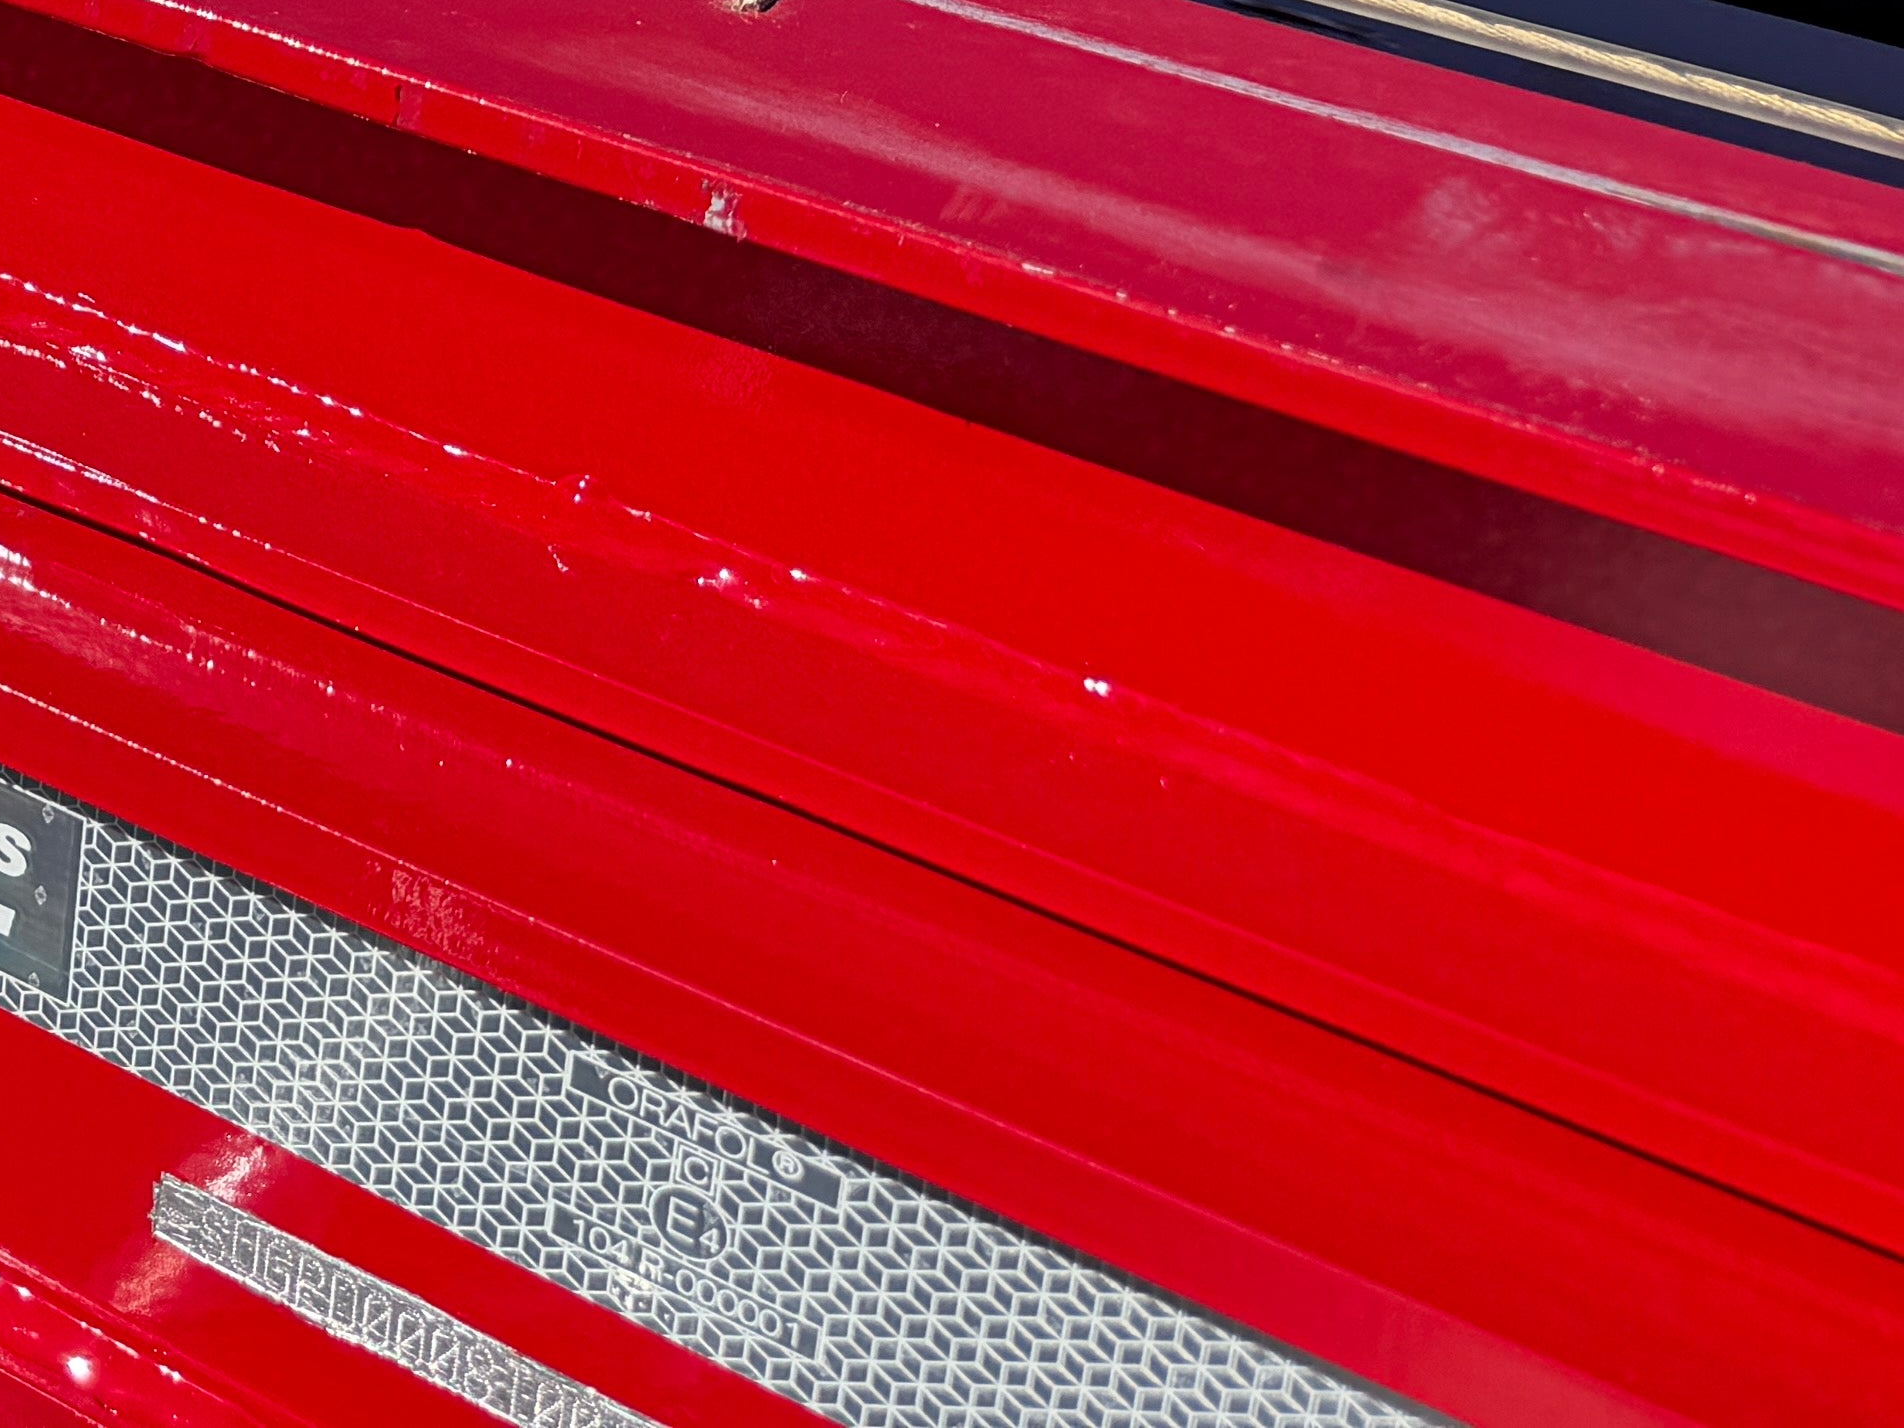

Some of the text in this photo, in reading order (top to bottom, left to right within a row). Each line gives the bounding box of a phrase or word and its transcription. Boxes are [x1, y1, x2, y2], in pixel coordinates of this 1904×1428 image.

[683, 1156, 710, 1185] C
[573, 1219, 799, 1349] 104 R-00001
